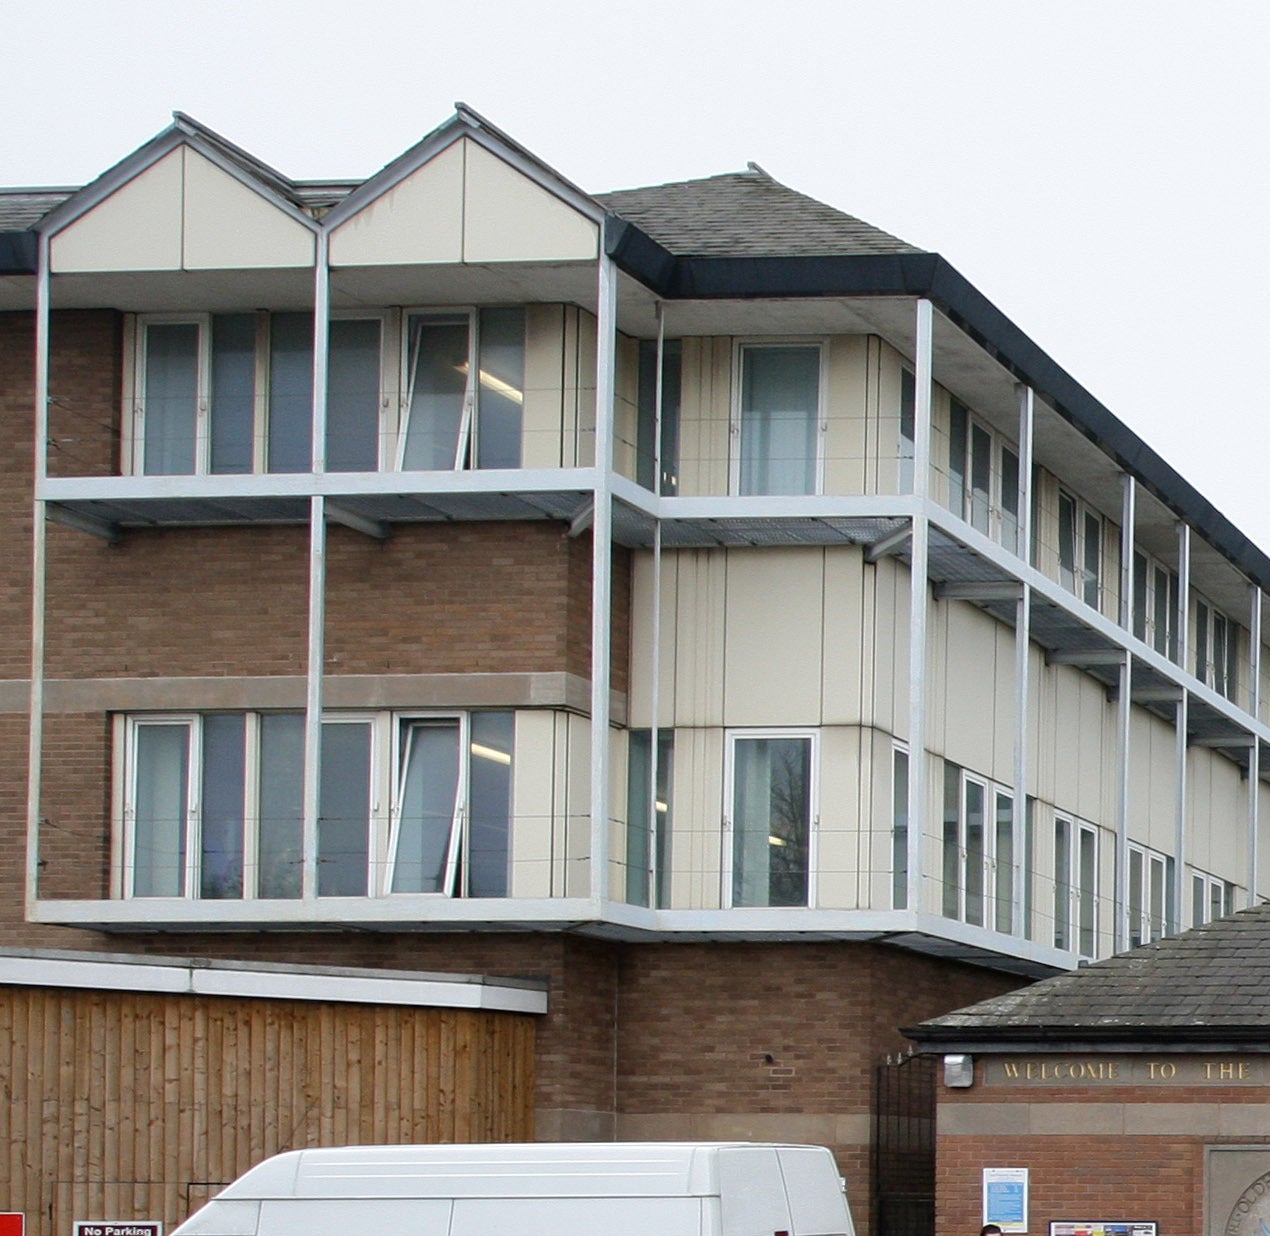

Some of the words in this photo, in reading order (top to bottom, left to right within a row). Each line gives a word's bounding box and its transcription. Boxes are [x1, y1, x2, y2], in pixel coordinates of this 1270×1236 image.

[1004, 1063, 1118, 1080] WELCOME
[1147, 1063, 1176, 1080] TO
[1204, 1063, 1249, 1080] THE
[84, 1227, 102, 1236] No
[105, 1226, 151, 1236] Parking
